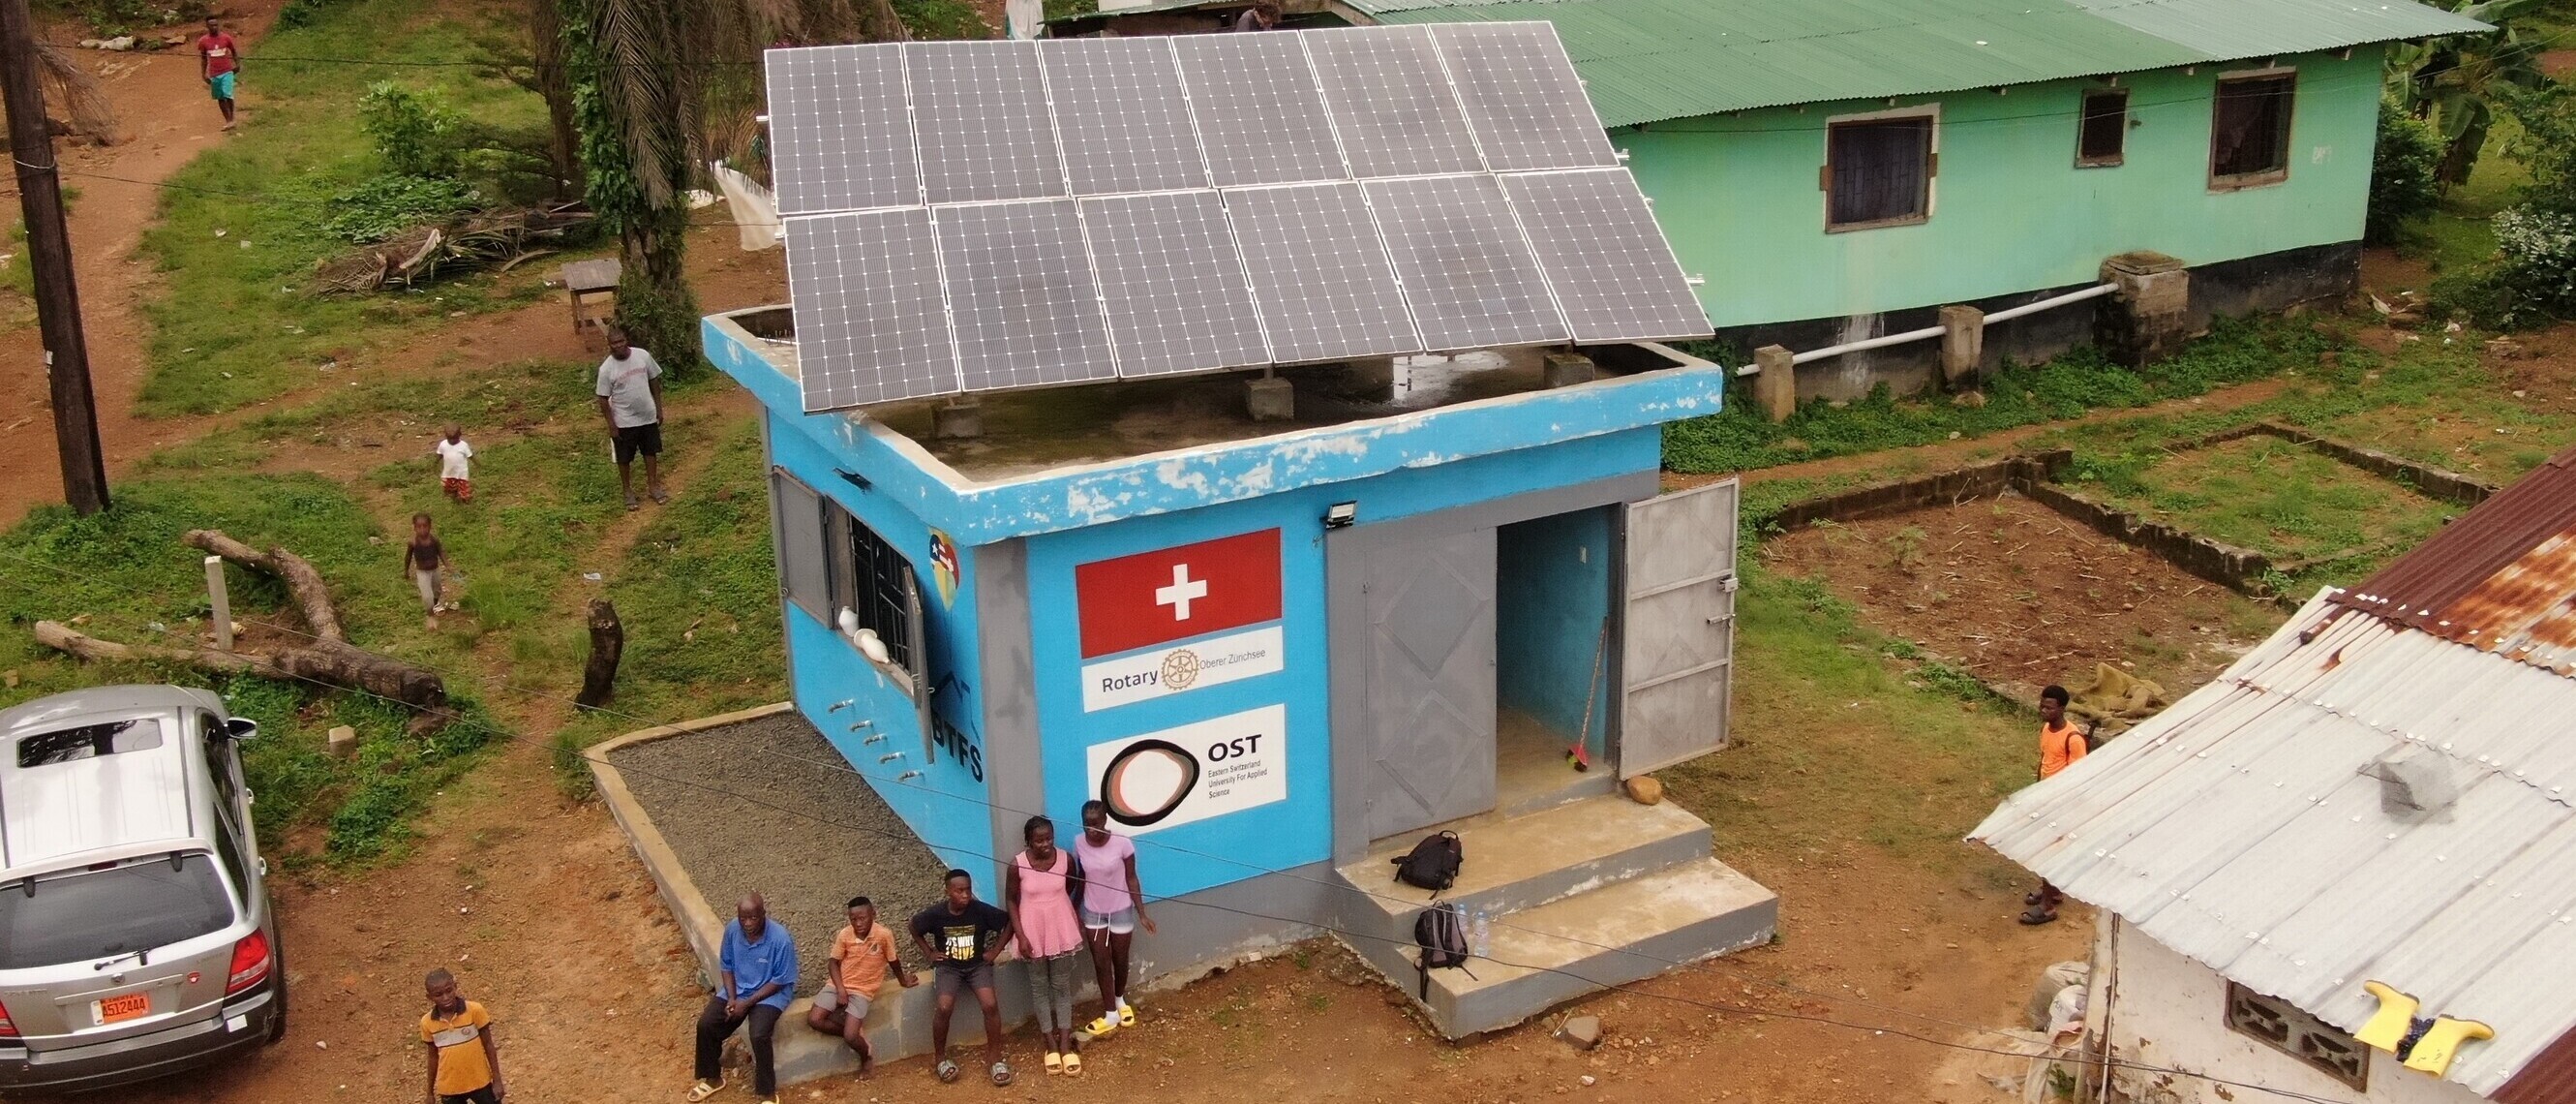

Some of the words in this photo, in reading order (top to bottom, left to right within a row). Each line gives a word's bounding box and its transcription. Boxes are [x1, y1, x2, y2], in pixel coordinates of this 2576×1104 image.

[1102, 669, 1159, 692] Rotary
[1199, 657, 1227, 670] Oberer
[1227, 649, 1266, 665] Zürichsee
[930, 709, 984, 783] BTFS
[1207, 733, 1262, 762] OST
[1207, 767, 1229, 779] Eastern
[1229, 759, 1261, 773] Switzerland
[1208, 776, 1236, 788] University
[1246, 768, 1268, 781] Applied
[1208, 788, 1230, 800] Science
